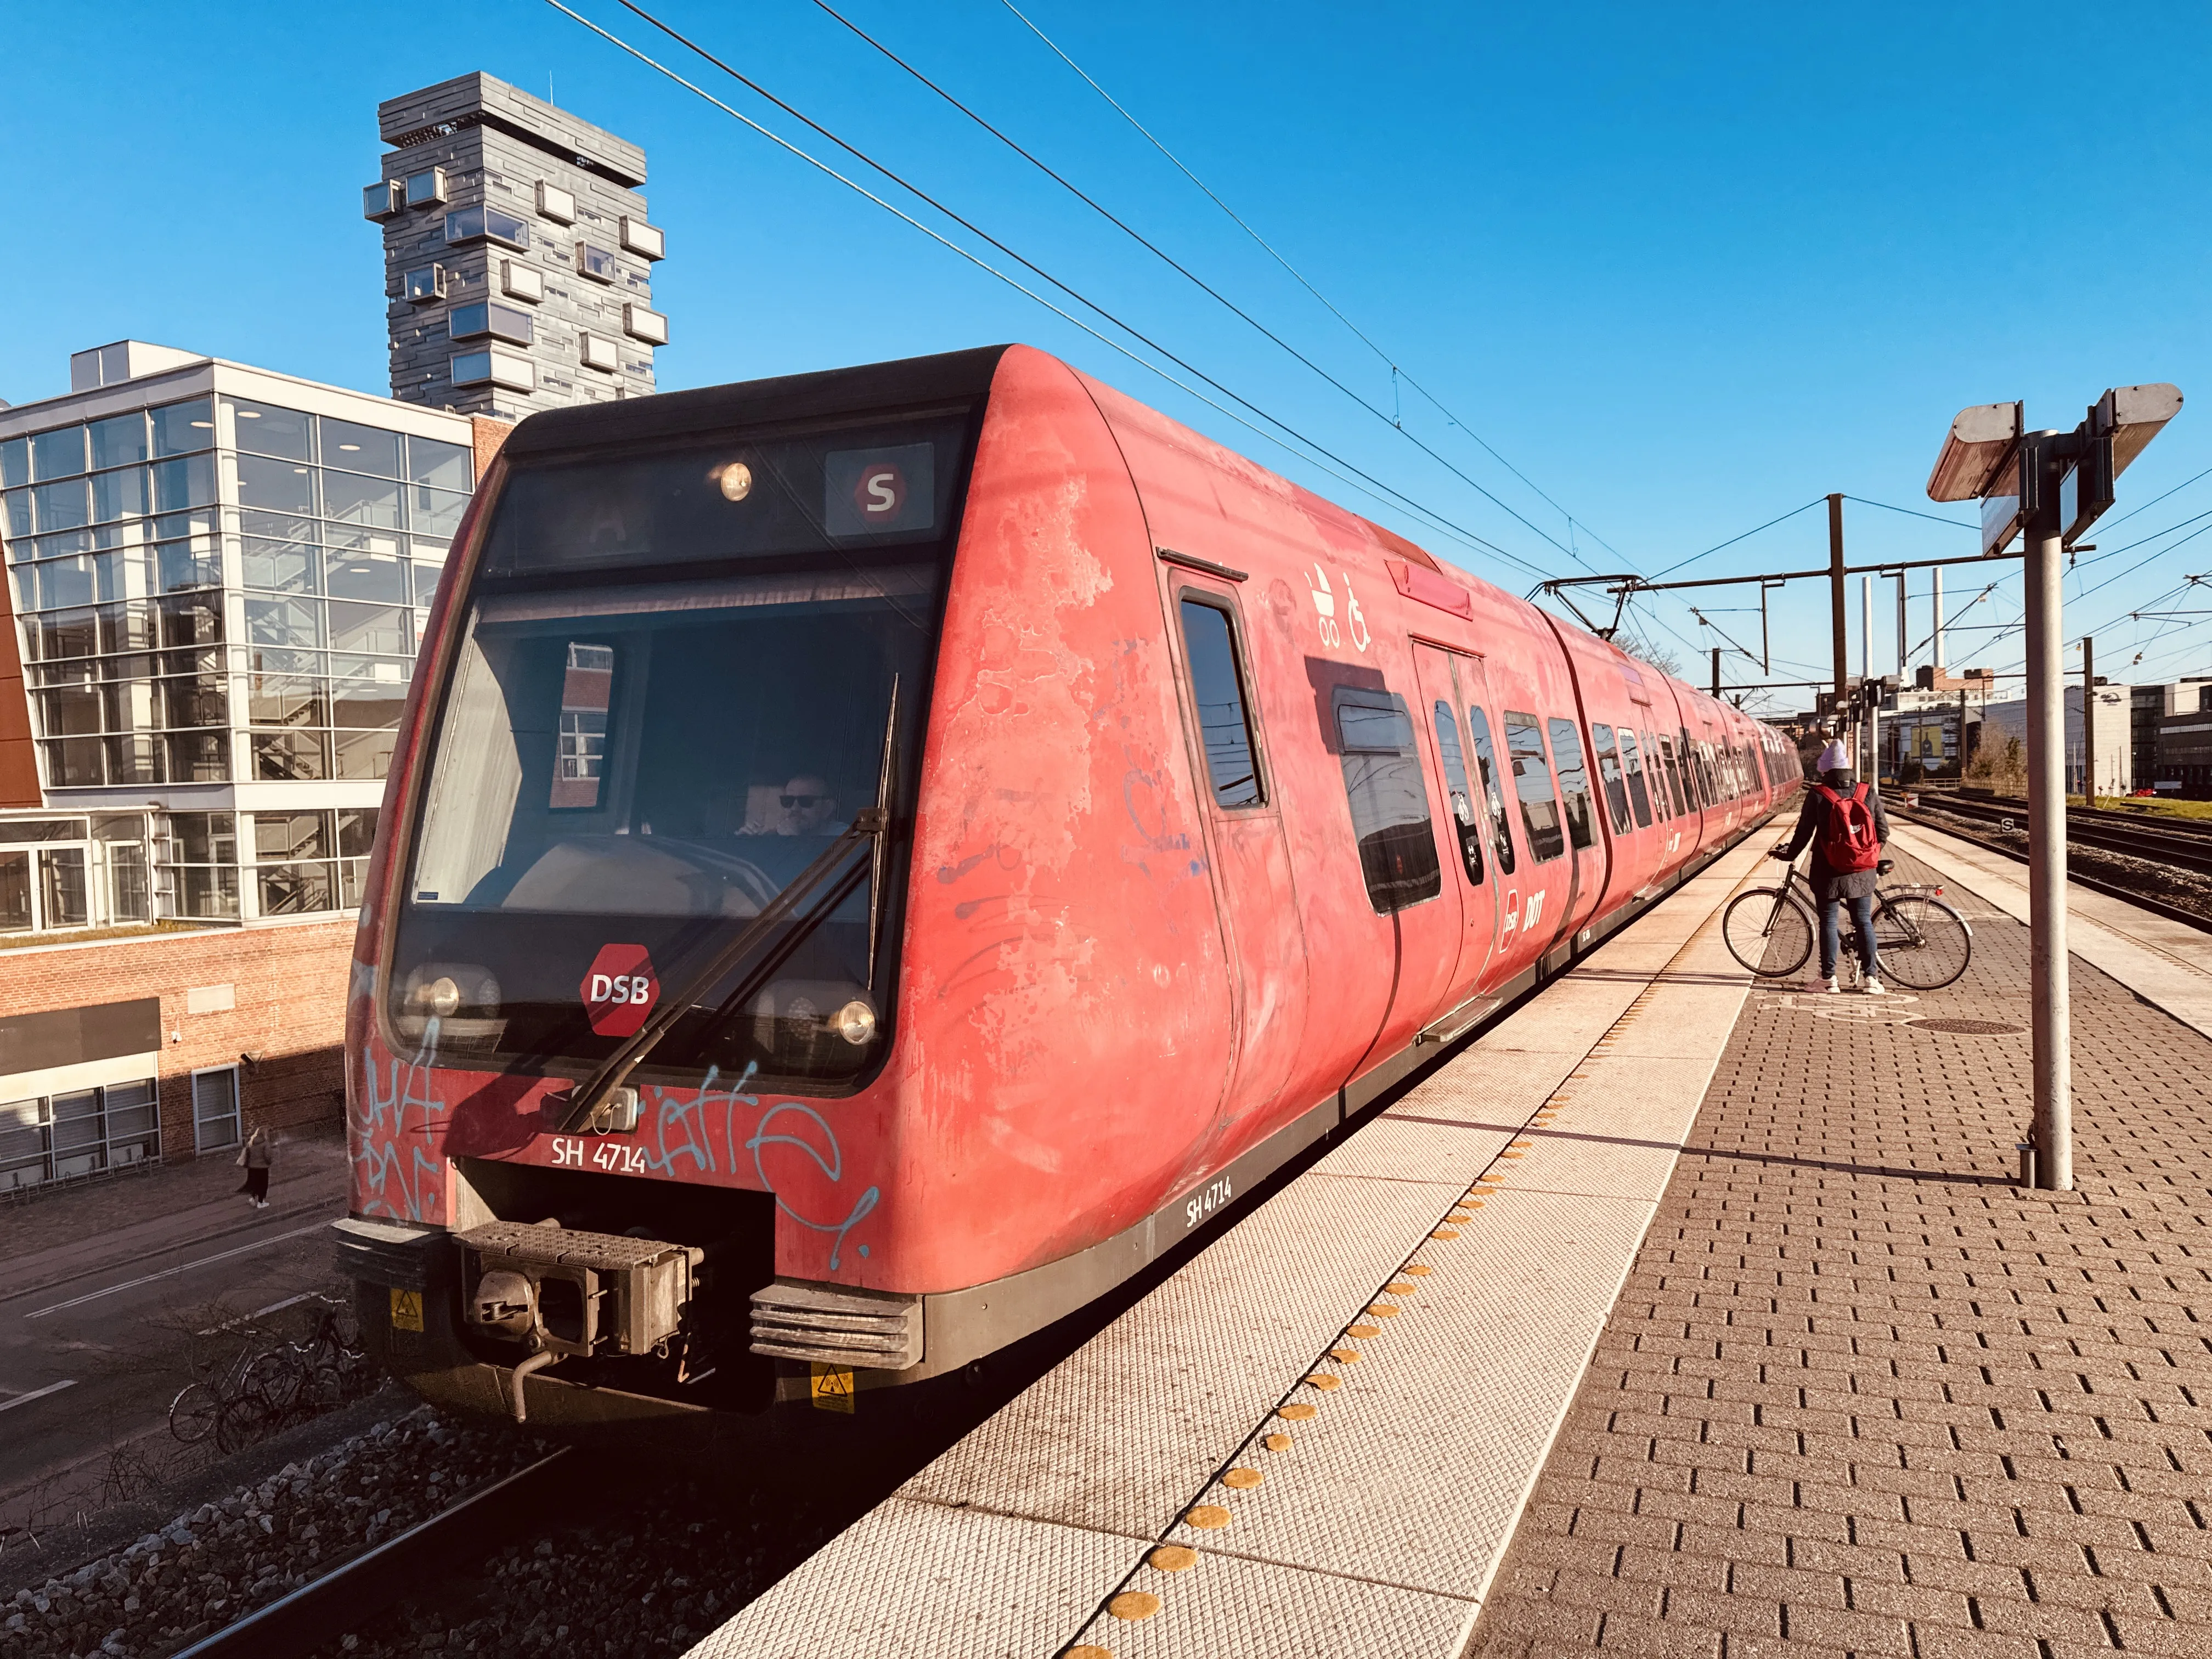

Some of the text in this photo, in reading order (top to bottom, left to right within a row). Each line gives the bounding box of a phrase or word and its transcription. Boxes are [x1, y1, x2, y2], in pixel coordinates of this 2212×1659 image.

[867, 473, 895, 512] S
[2002, 820, 2013, 831] S
[1505, 911, 1517, 933] DSB
[1522, 889, 1545, 933] DOT
[591, 974, 649, 1005] DSB
[551, 1138, 646, 1174] SH 4714
[1187, 1176, 1231, 1228] SH 4714
